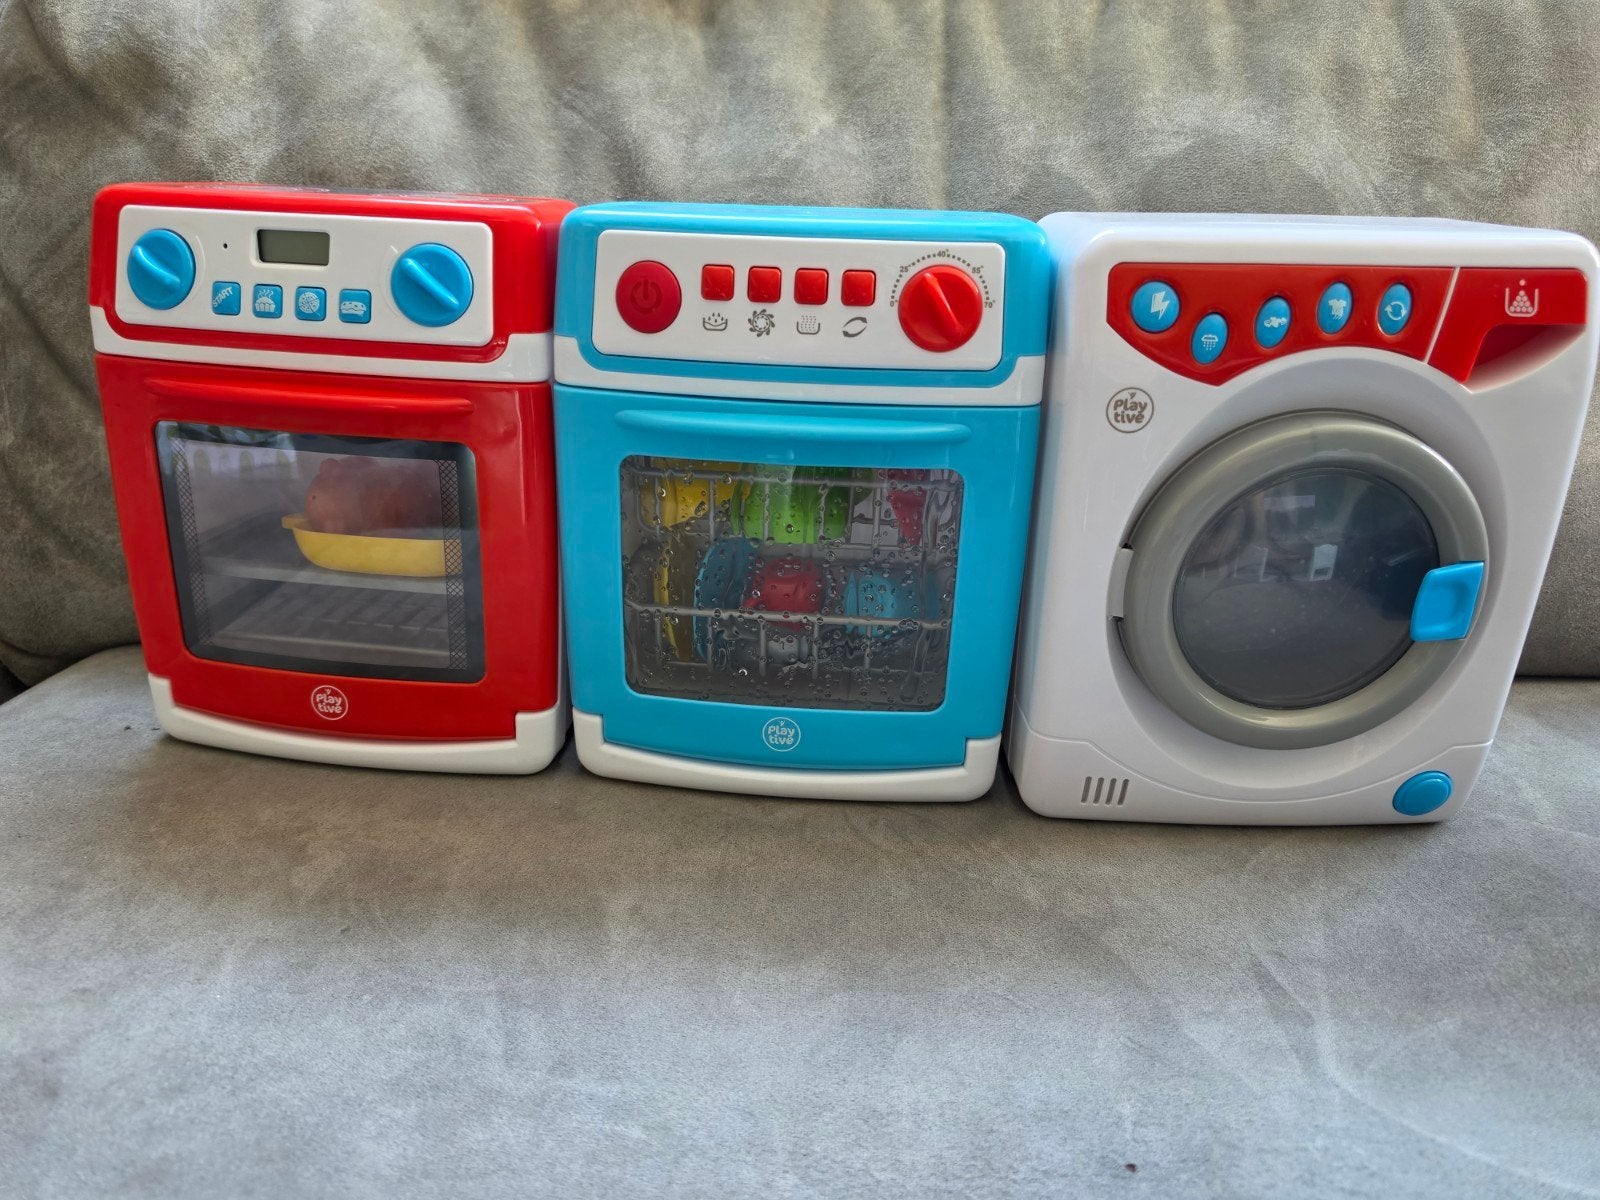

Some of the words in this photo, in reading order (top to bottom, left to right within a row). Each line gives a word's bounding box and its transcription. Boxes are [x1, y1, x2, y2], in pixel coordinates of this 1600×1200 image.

[213, 286, 233, 308] START
[1113, 398, 1148, 414] Play
[1114, 410, 1145, 424] tive
[316, 693, 342, 706] Play
[318, 702, 342, 714] tive
[767, 725, 795, 737] Play
[769, 734, 794, 745] tive
